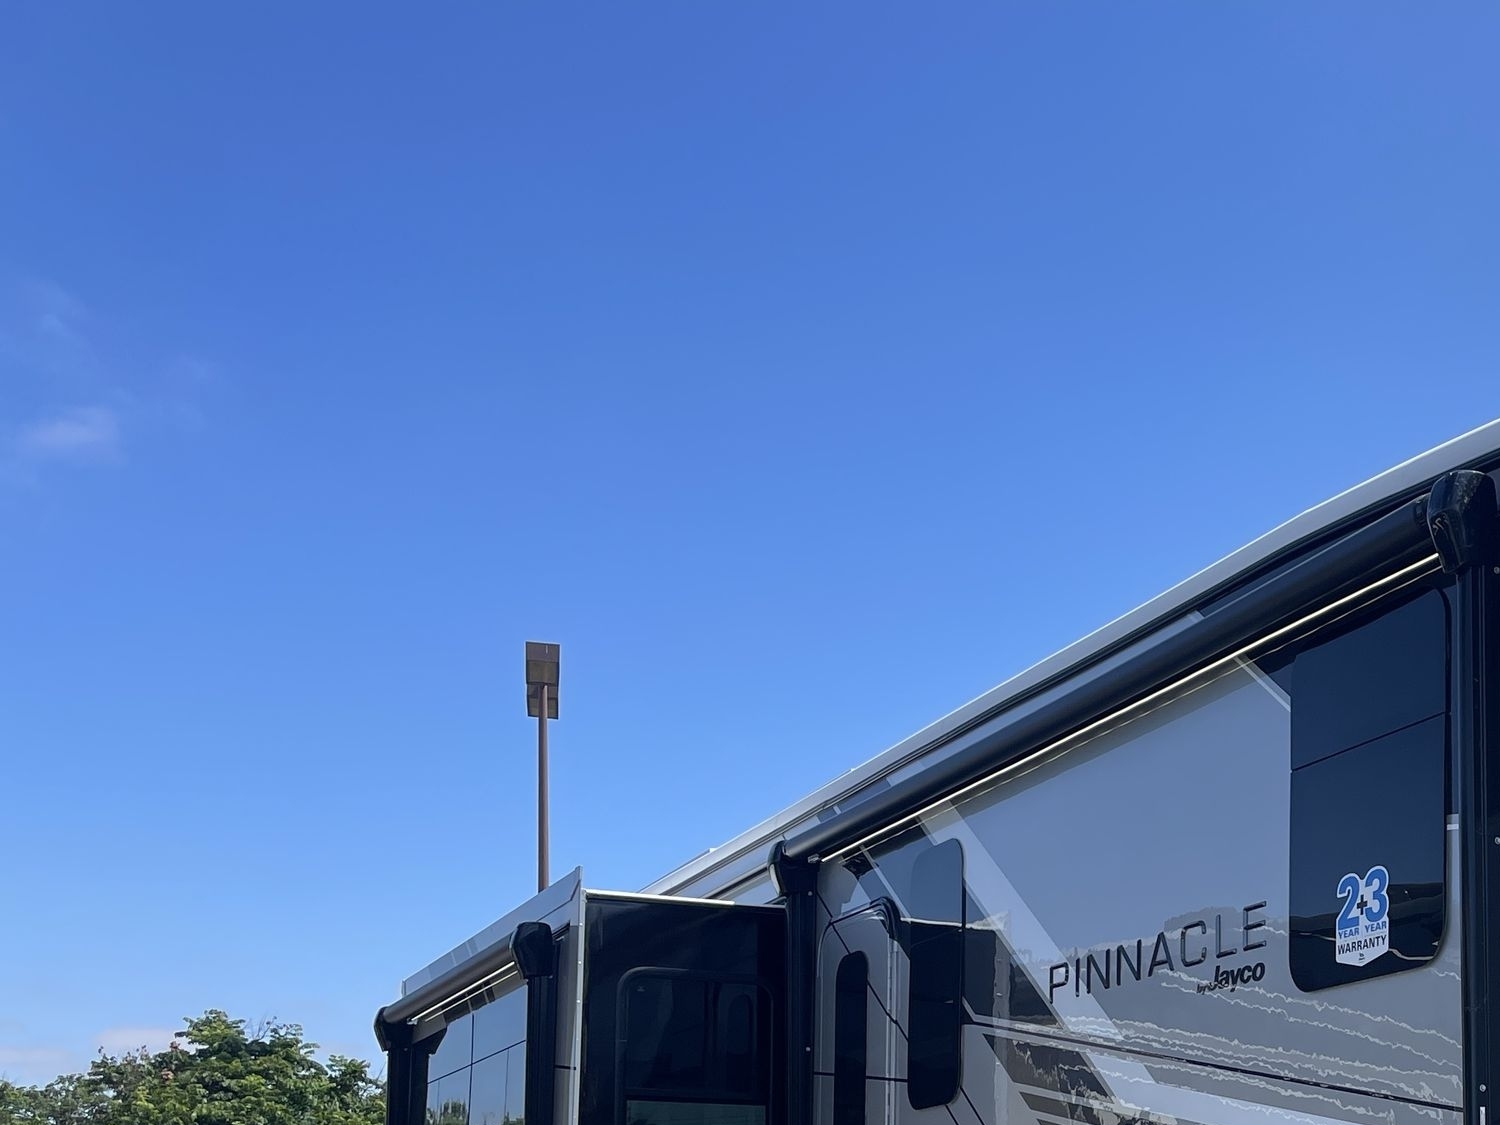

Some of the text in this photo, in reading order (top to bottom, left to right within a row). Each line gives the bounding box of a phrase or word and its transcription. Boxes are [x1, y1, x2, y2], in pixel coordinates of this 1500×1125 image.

[1338, 920, 1387, 940] YEAR YEAR
[1049, 900, 1267, 1004] PINNACLE
[1337, 934, 1387, 956] WARRANTY
[1207, 962, 1266, 993] Jayco
